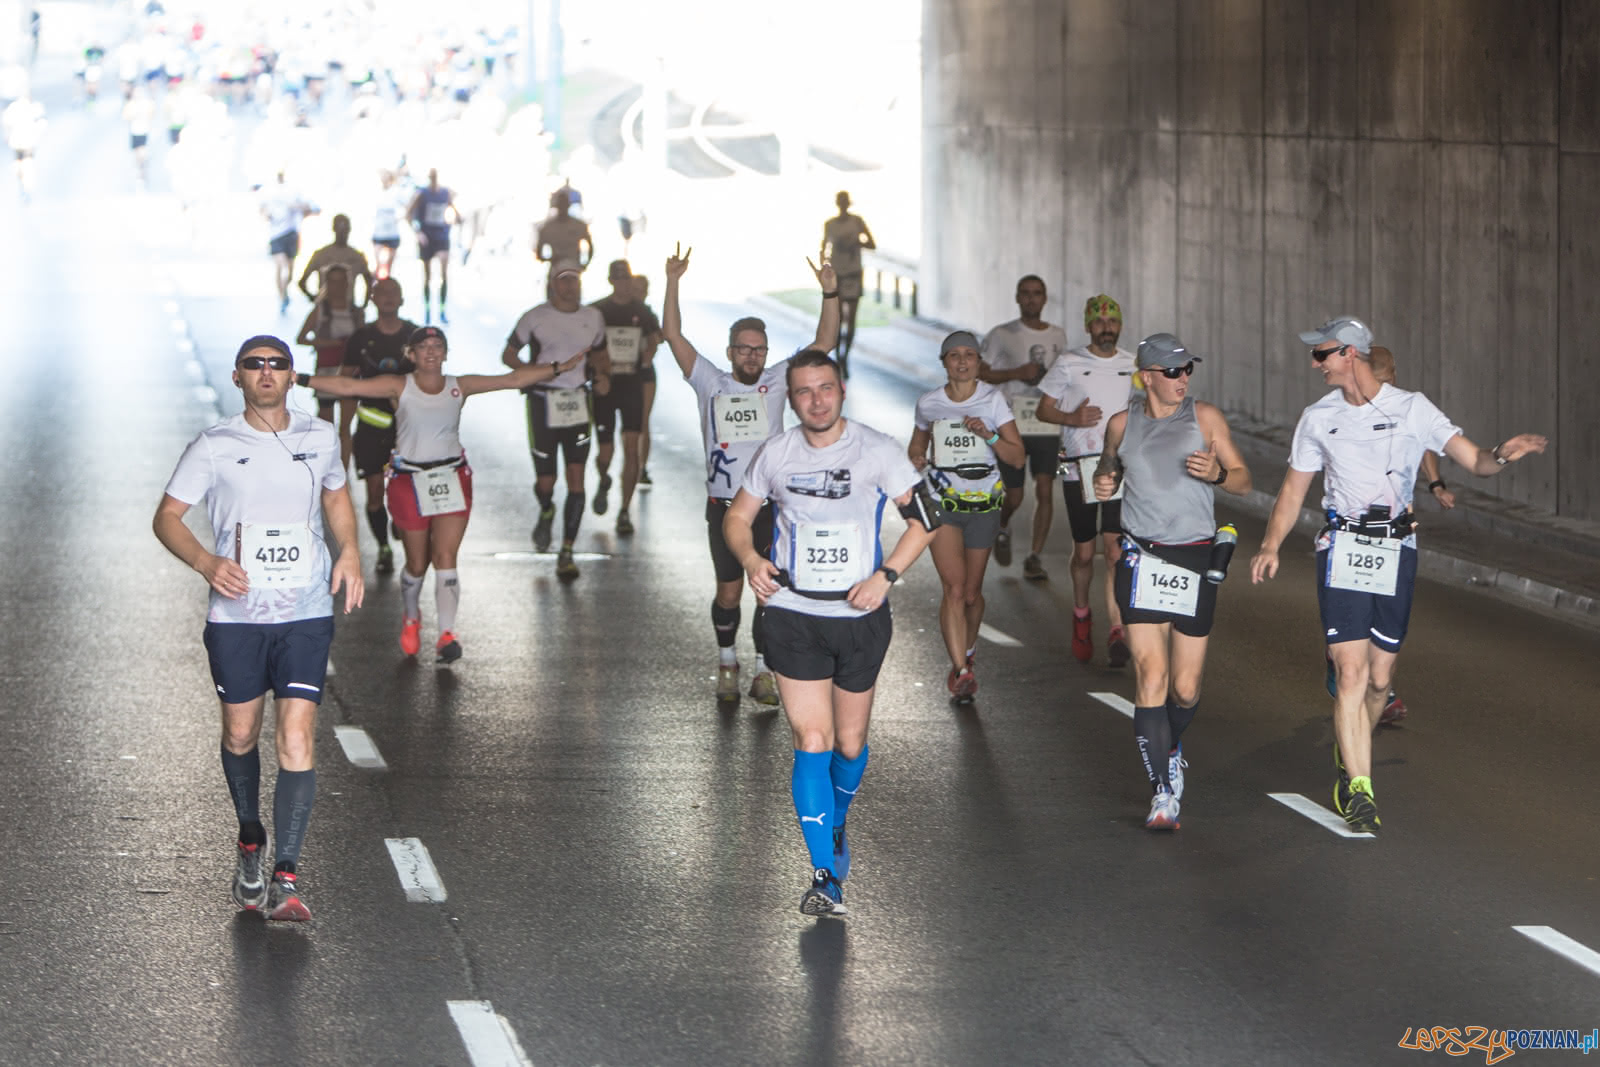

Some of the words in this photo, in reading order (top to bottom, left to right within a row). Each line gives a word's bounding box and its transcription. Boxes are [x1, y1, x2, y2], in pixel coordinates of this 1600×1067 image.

[725, 409, 758, 422] 4051
[944, 435, 976, 448] 4881
[428, 483, 450, 497] 603
[255, 546, 300, 562] 4120
[807, 547, 849, 563] 3238
[1346, 552, 1385, 570] 1289
[1151, 573, 1189, 591] 1463
